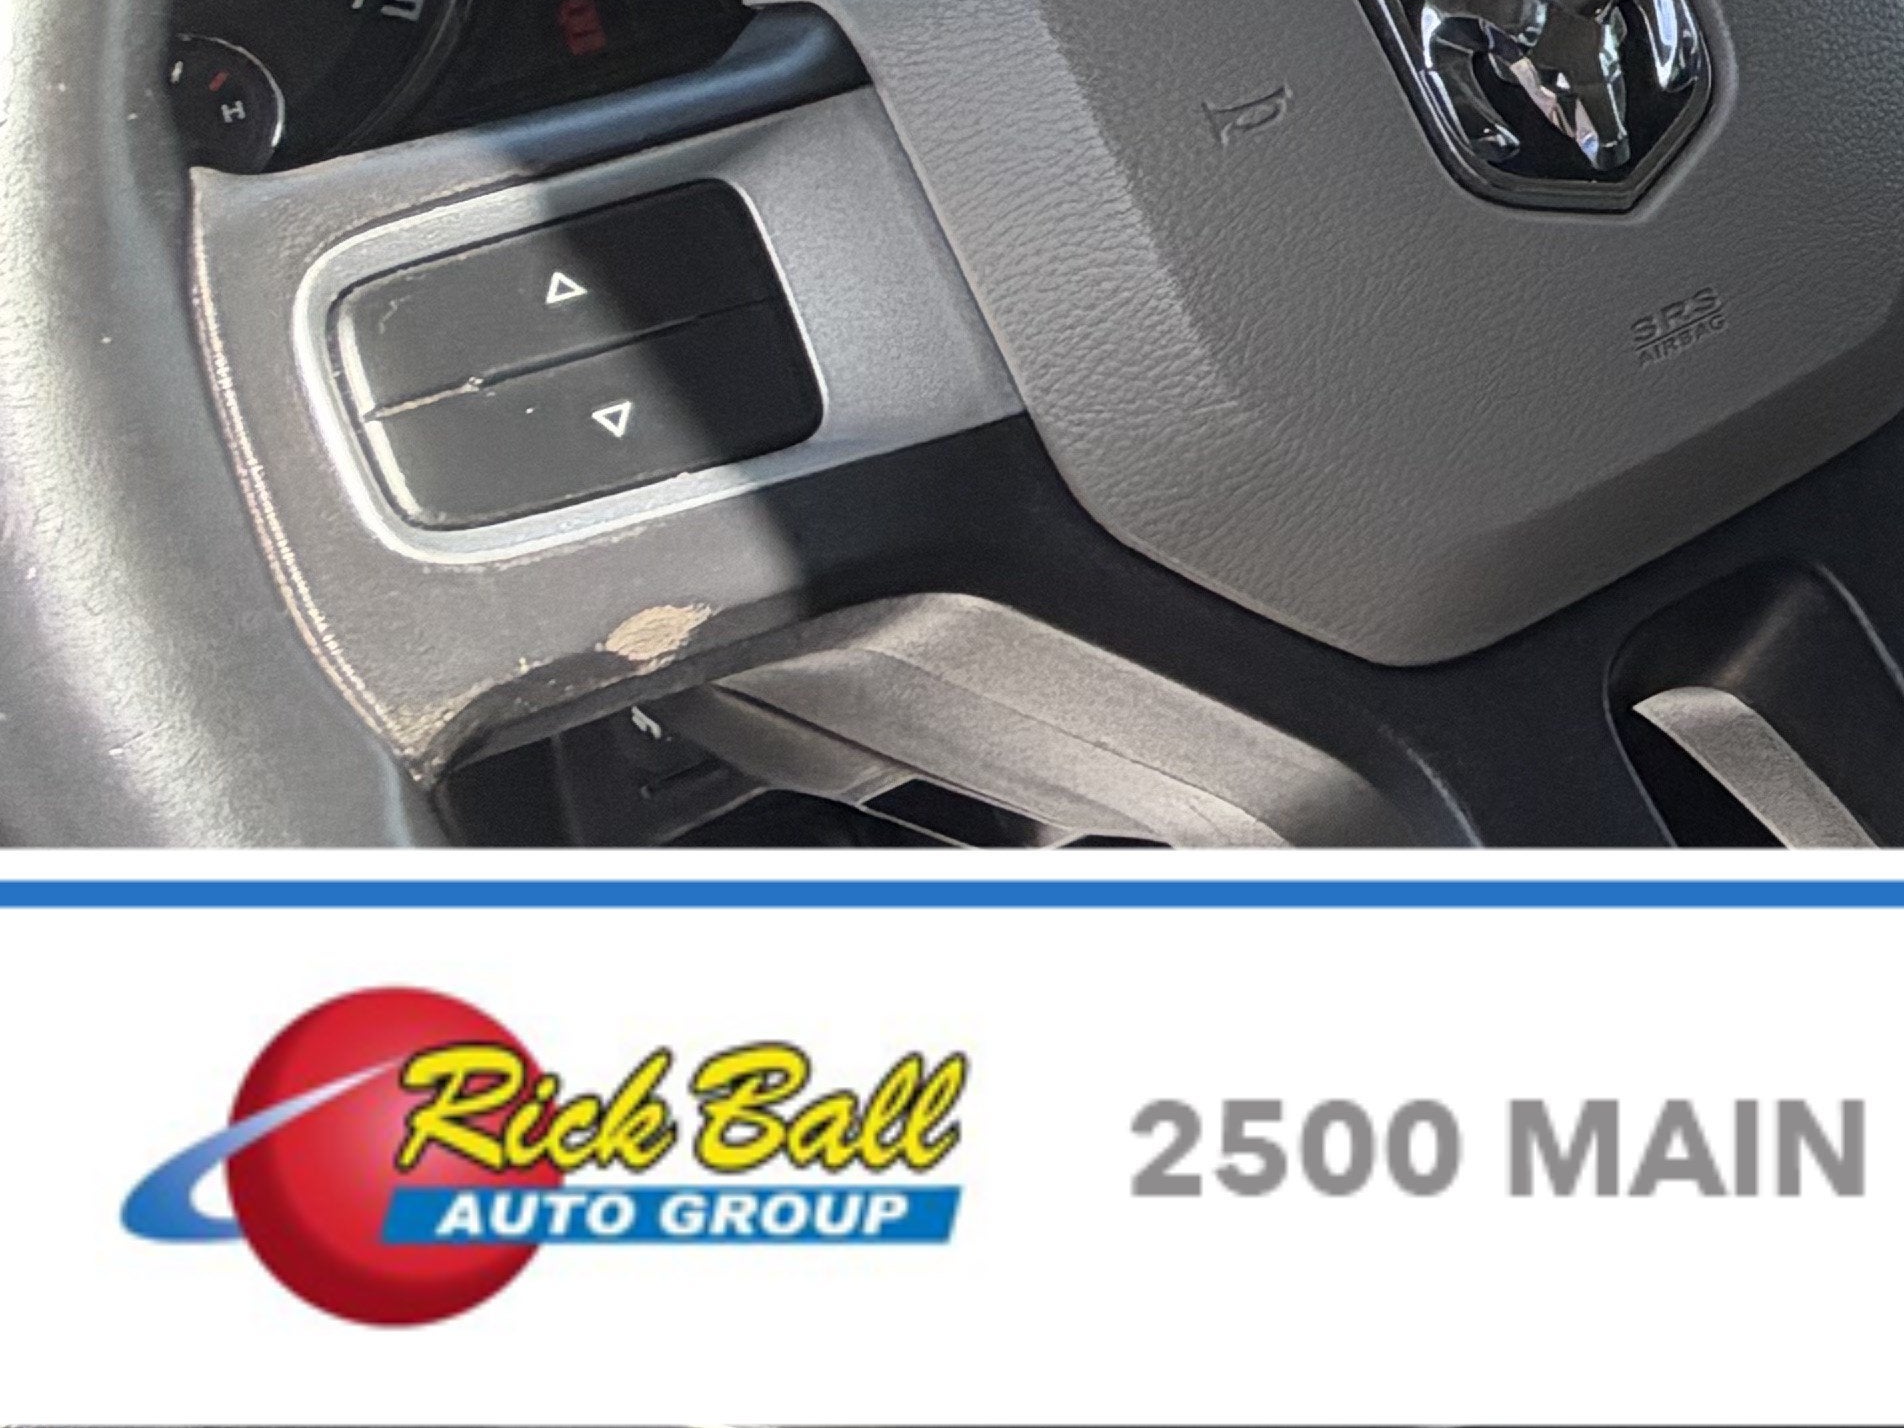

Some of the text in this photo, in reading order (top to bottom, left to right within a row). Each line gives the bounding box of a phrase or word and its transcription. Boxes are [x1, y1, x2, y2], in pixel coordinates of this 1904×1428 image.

[221, 100, 246, 124] H
[1630, 286, 1721, 342] SRS
[1638, 313, 1728, 366] AIRBAG
